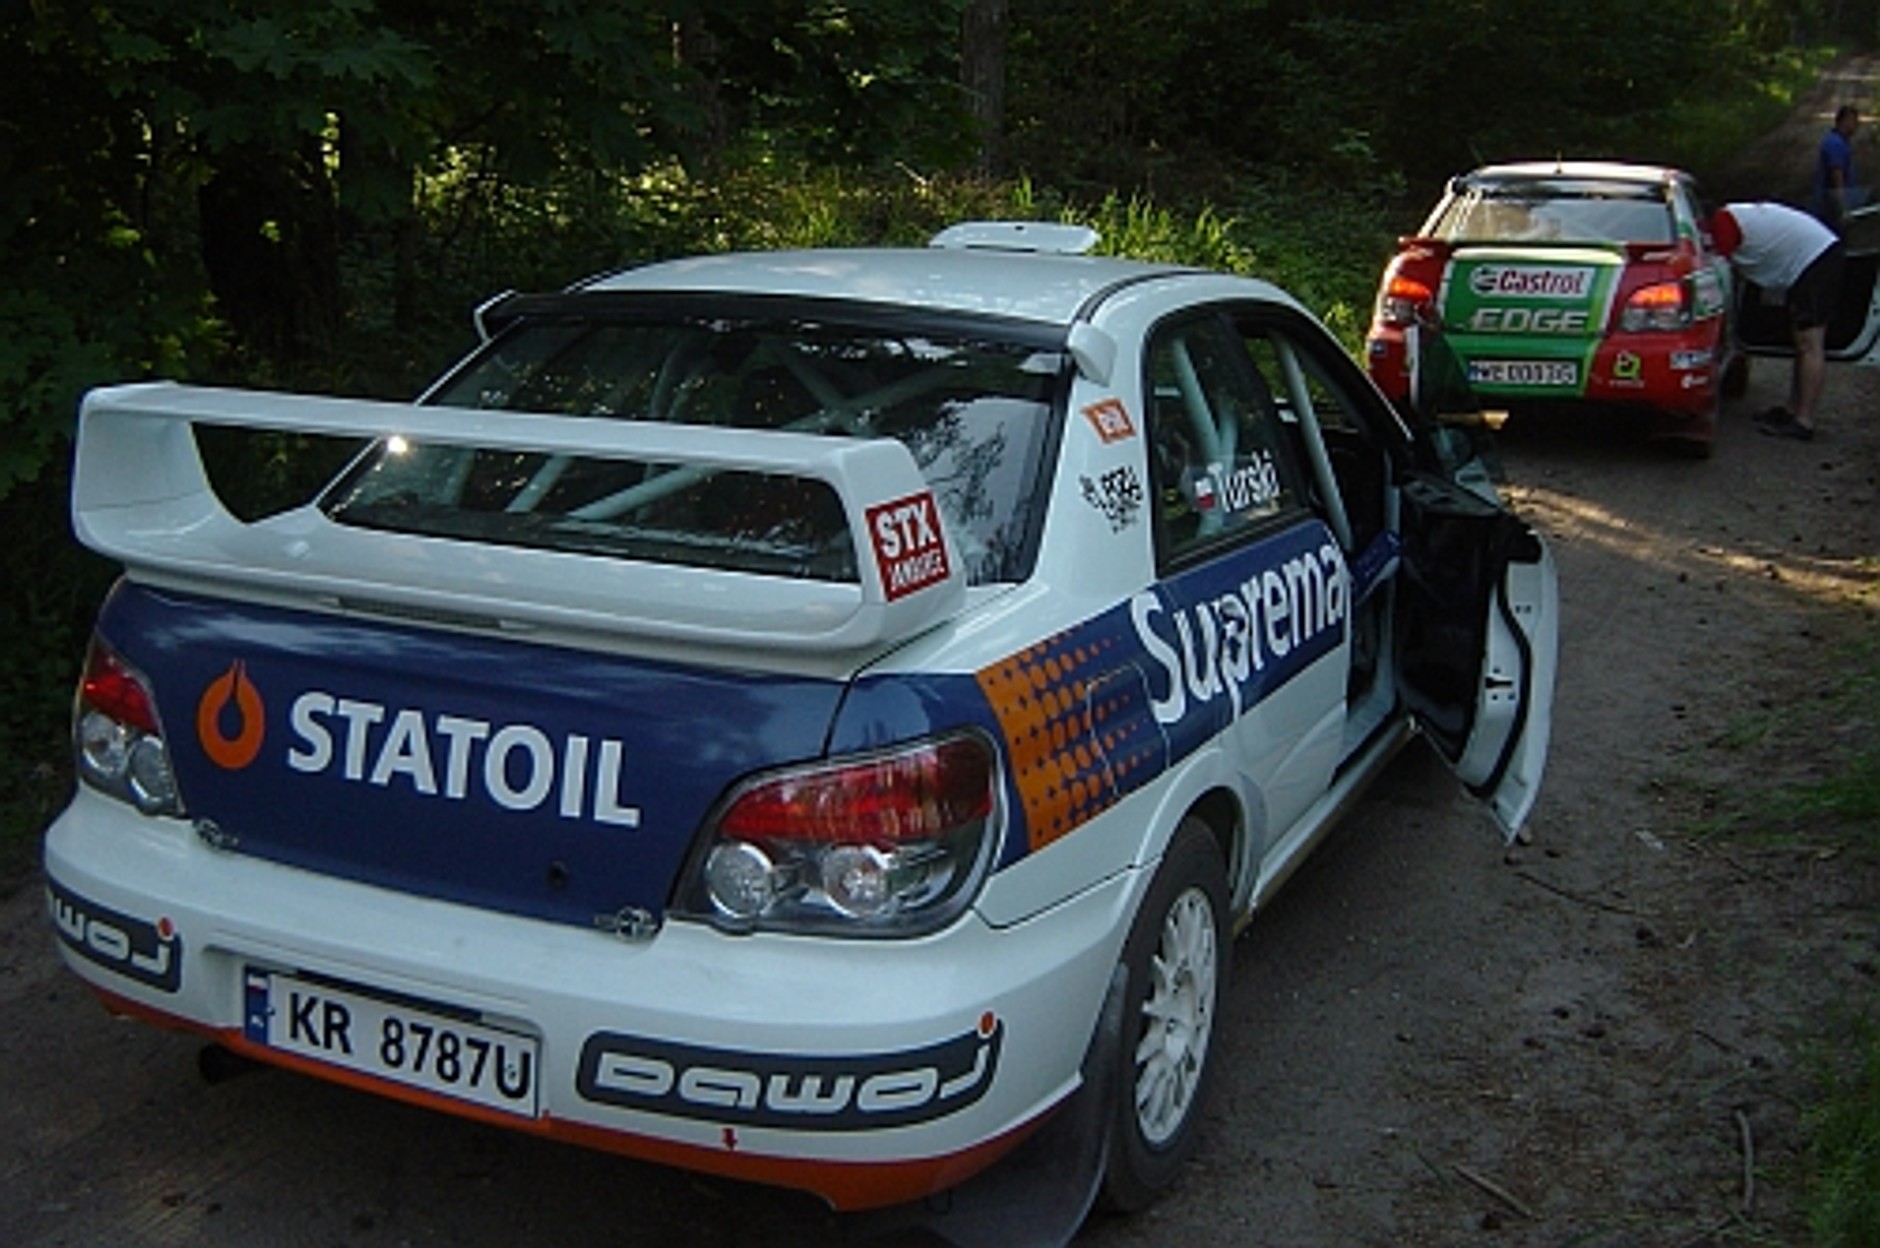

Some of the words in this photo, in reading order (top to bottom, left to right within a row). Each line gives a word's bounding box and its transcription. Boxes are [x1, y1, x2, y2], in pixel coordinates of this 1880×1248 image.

[1499, 269, 1585, 295] Castrol
[1470, 307, 1589, 333] EDGE
[1206, 447, 1280, 513] Turski
[876, 499, 938, 559] STX
[1131, 543, 1347, 723] Suprema
[287, 691, 641, 828] STATOIL
[289, 992, 352, 1054] KR
[379, 1015, 532, 1100] 8787U
